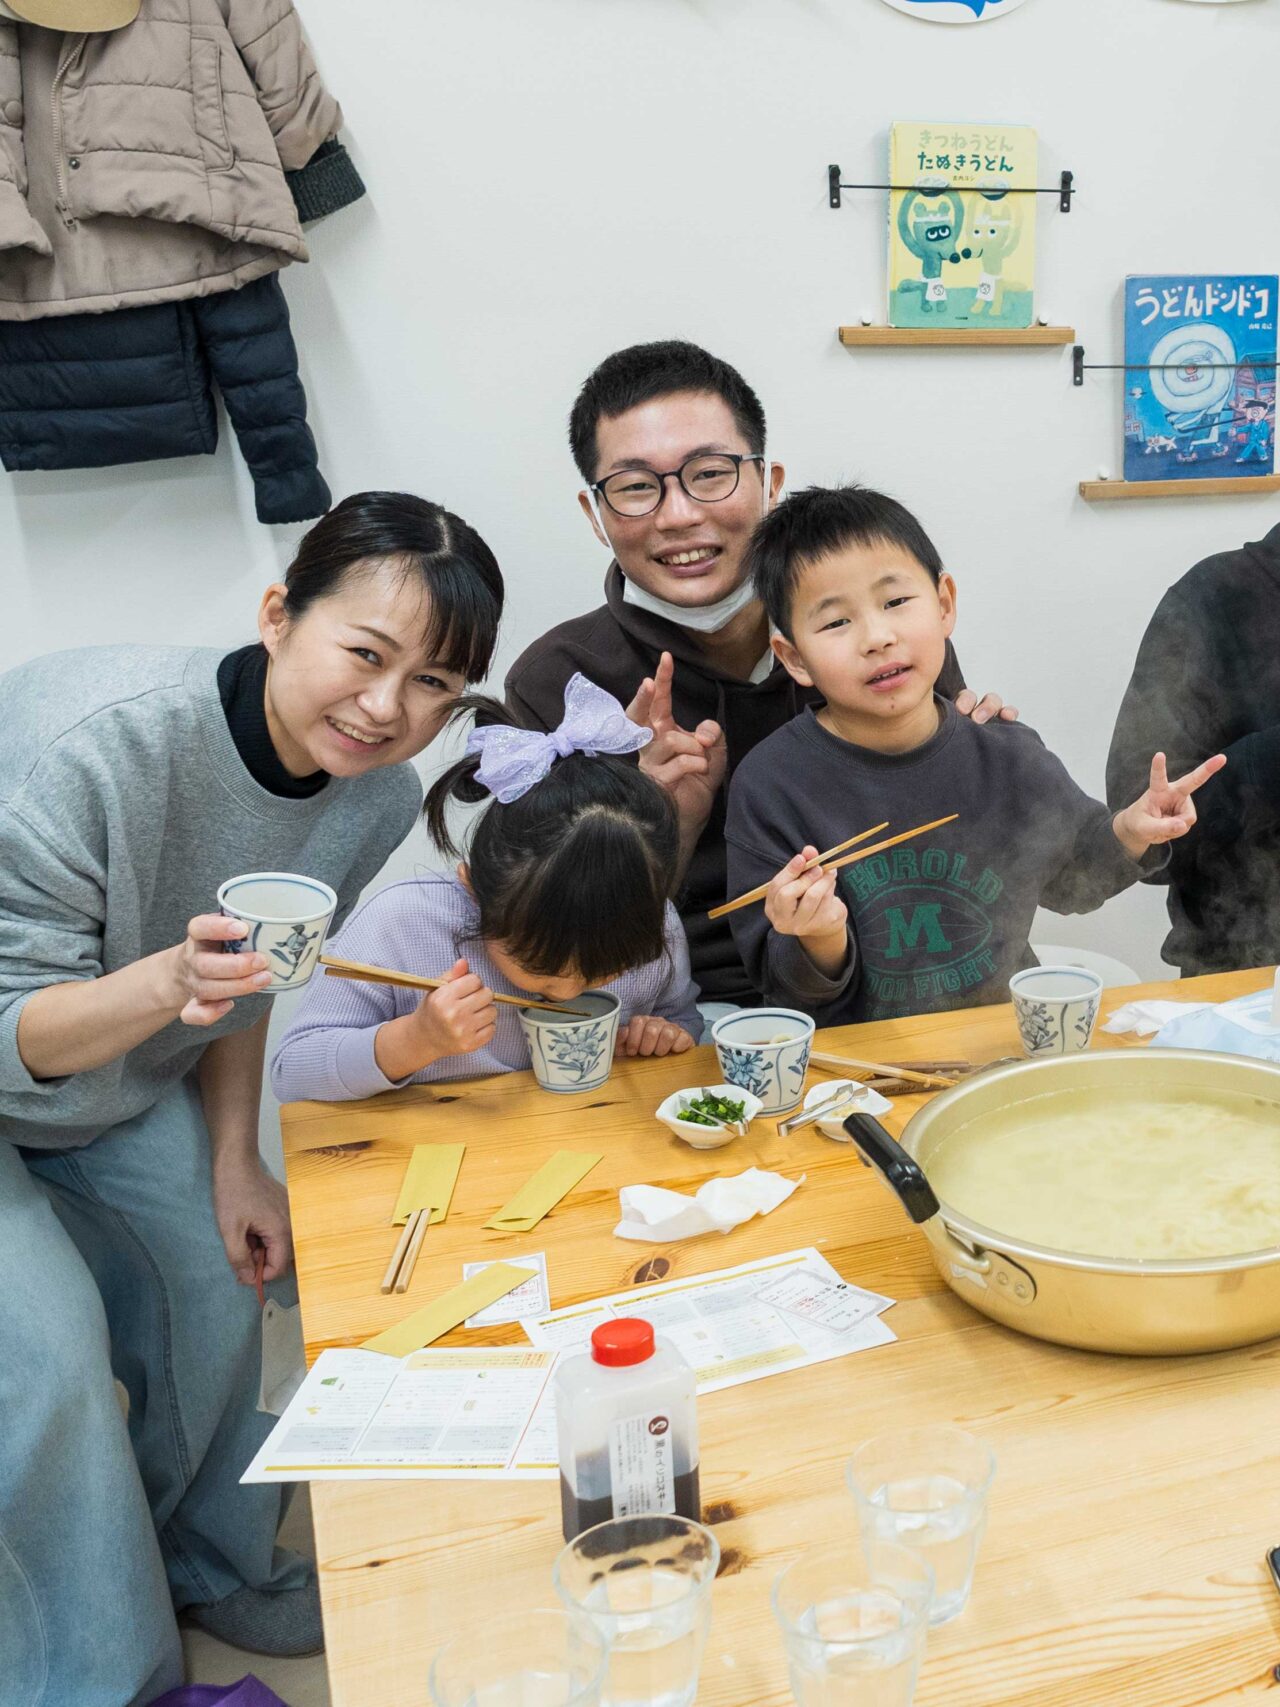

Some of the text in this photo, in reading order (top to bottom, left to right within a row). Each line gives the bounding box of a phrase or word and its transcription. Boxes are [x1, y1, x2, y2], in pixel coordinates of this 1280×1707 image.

[917, 129, 1014, 152] きつねうどん
[917, 151, 1014, 173] たぬきうどん
[1134, 283, 1270, 326] うどんドンドコ
[884, 903, 952, 960] M
[913, 948, 998, 1000] FIGHT
